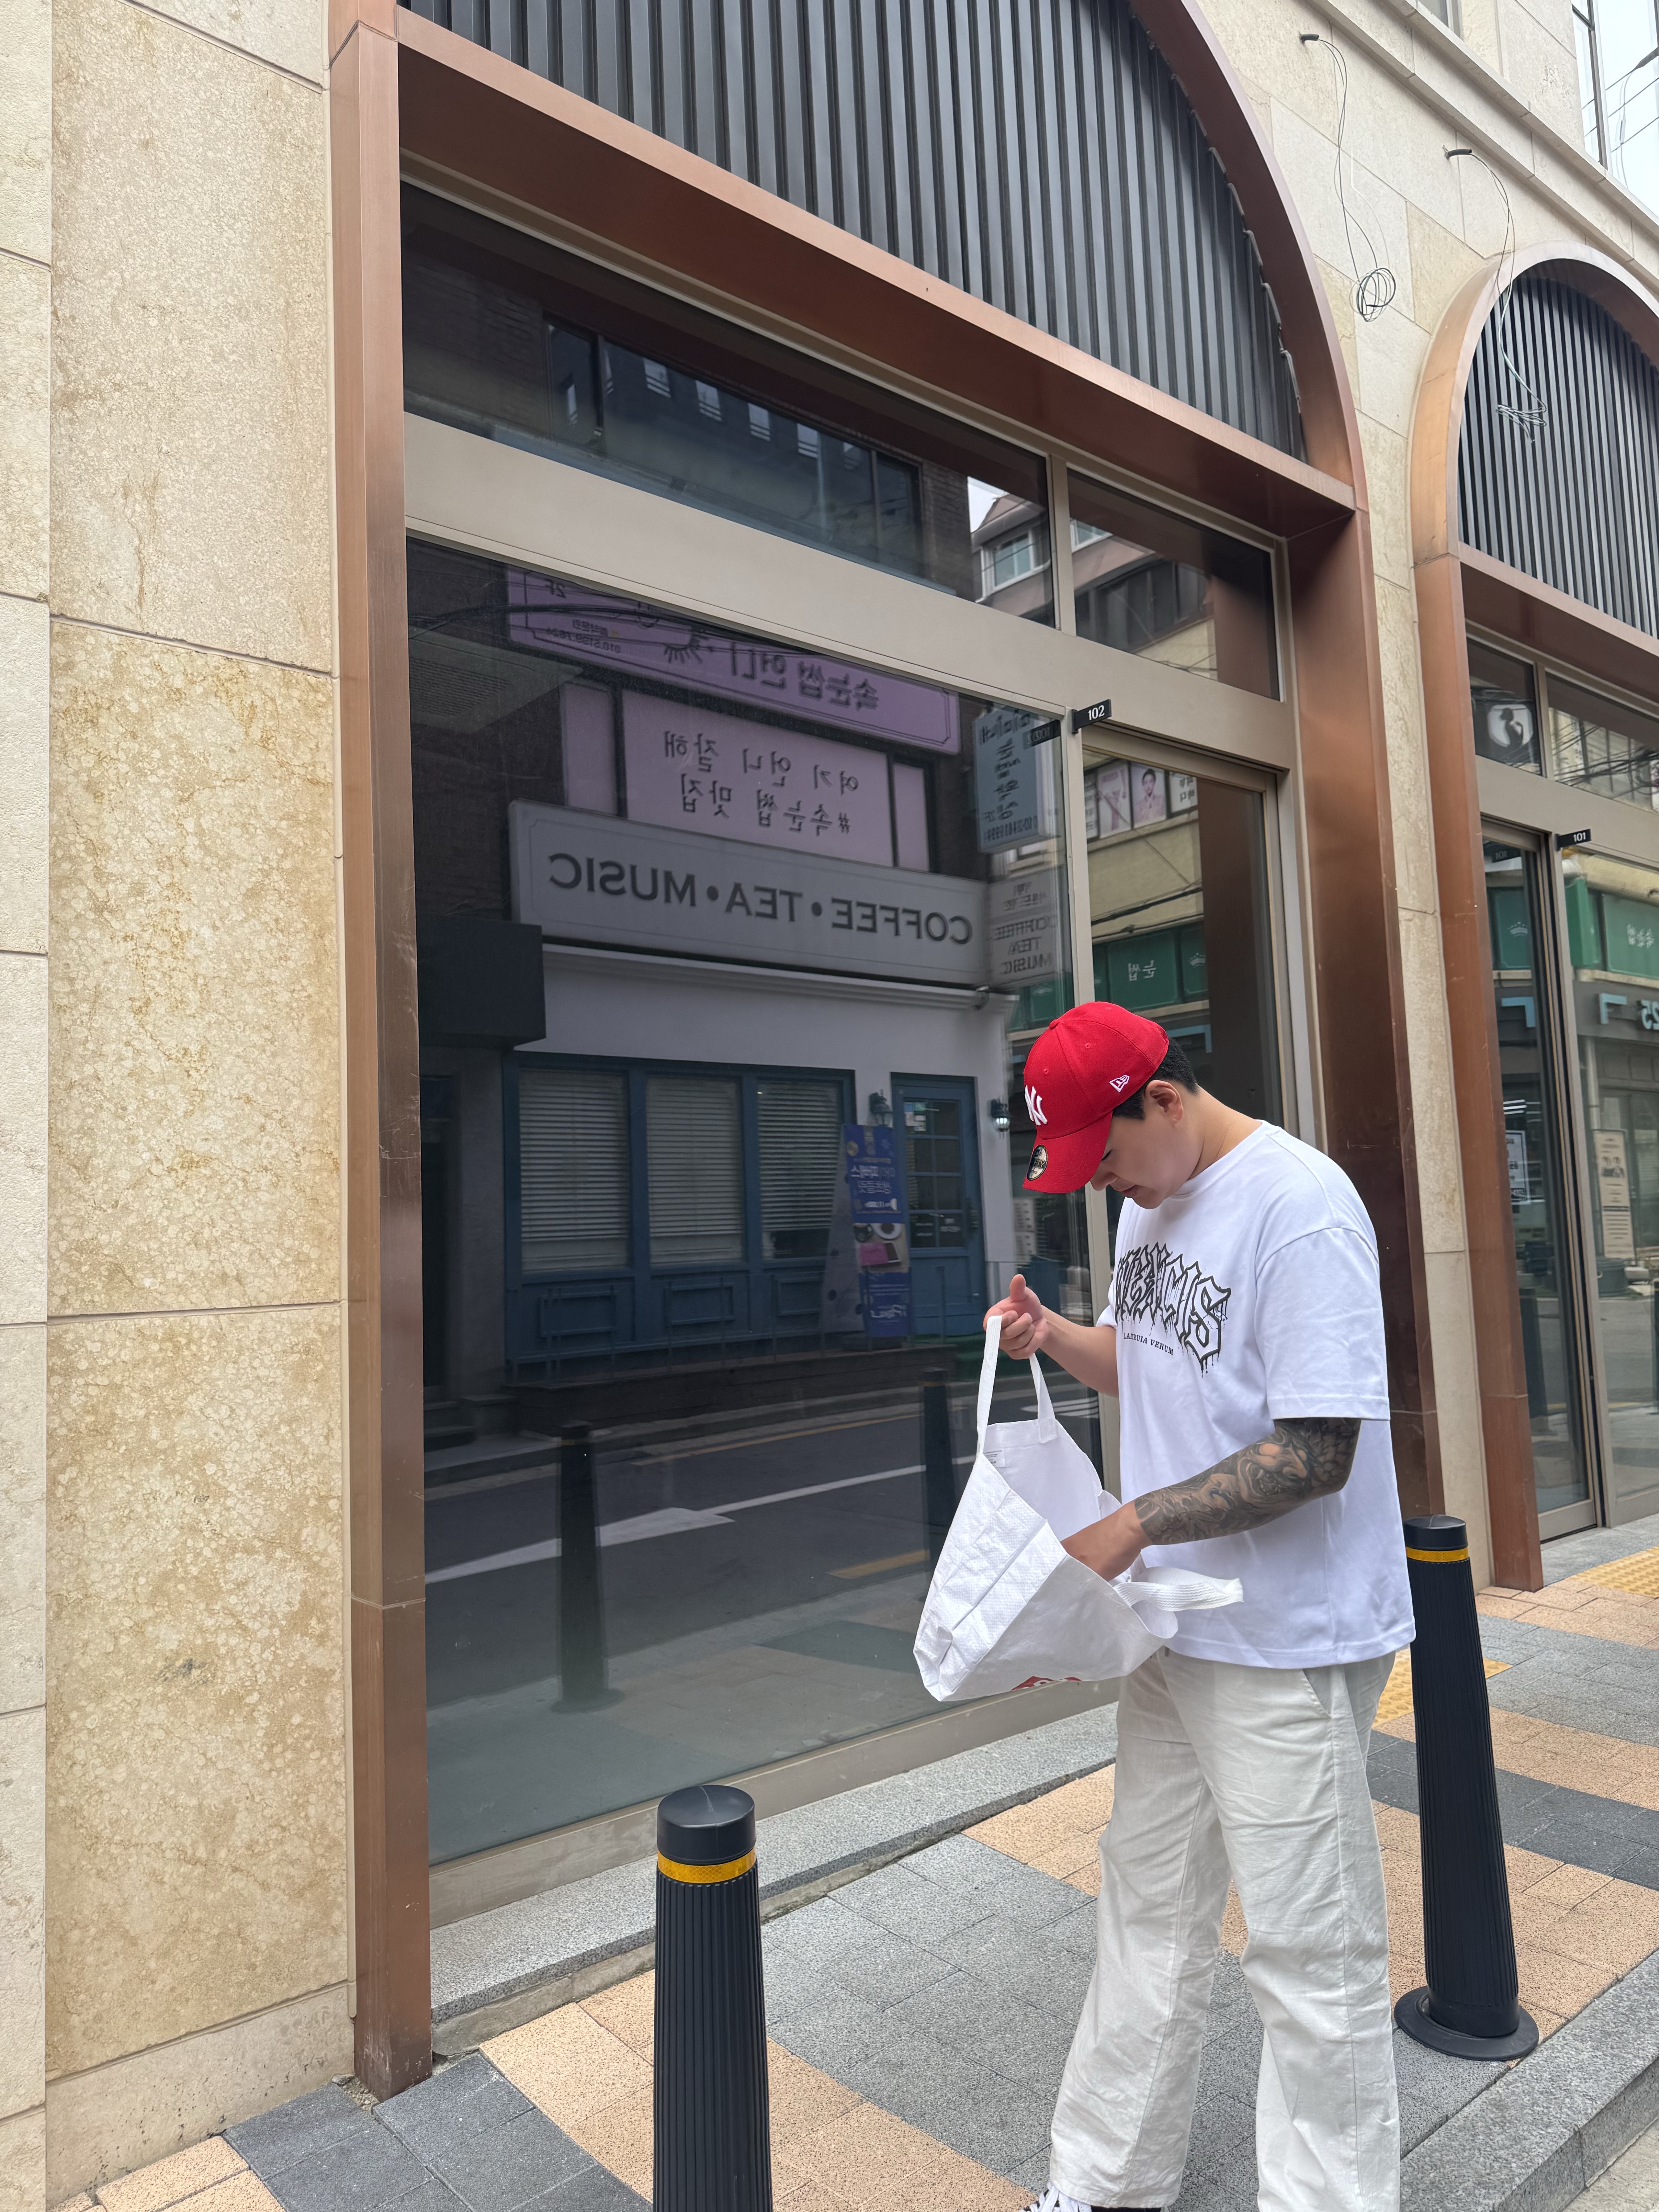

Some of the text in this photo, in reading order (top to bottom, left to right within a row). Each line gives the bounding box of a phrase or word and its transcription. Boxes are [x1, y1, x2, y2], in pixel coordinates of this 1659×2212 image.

[1087, 705, 1105, 721] 102
[1573, 832, 1587, 842] 101
[1151, 1339, 1173, 1355] VERUM
